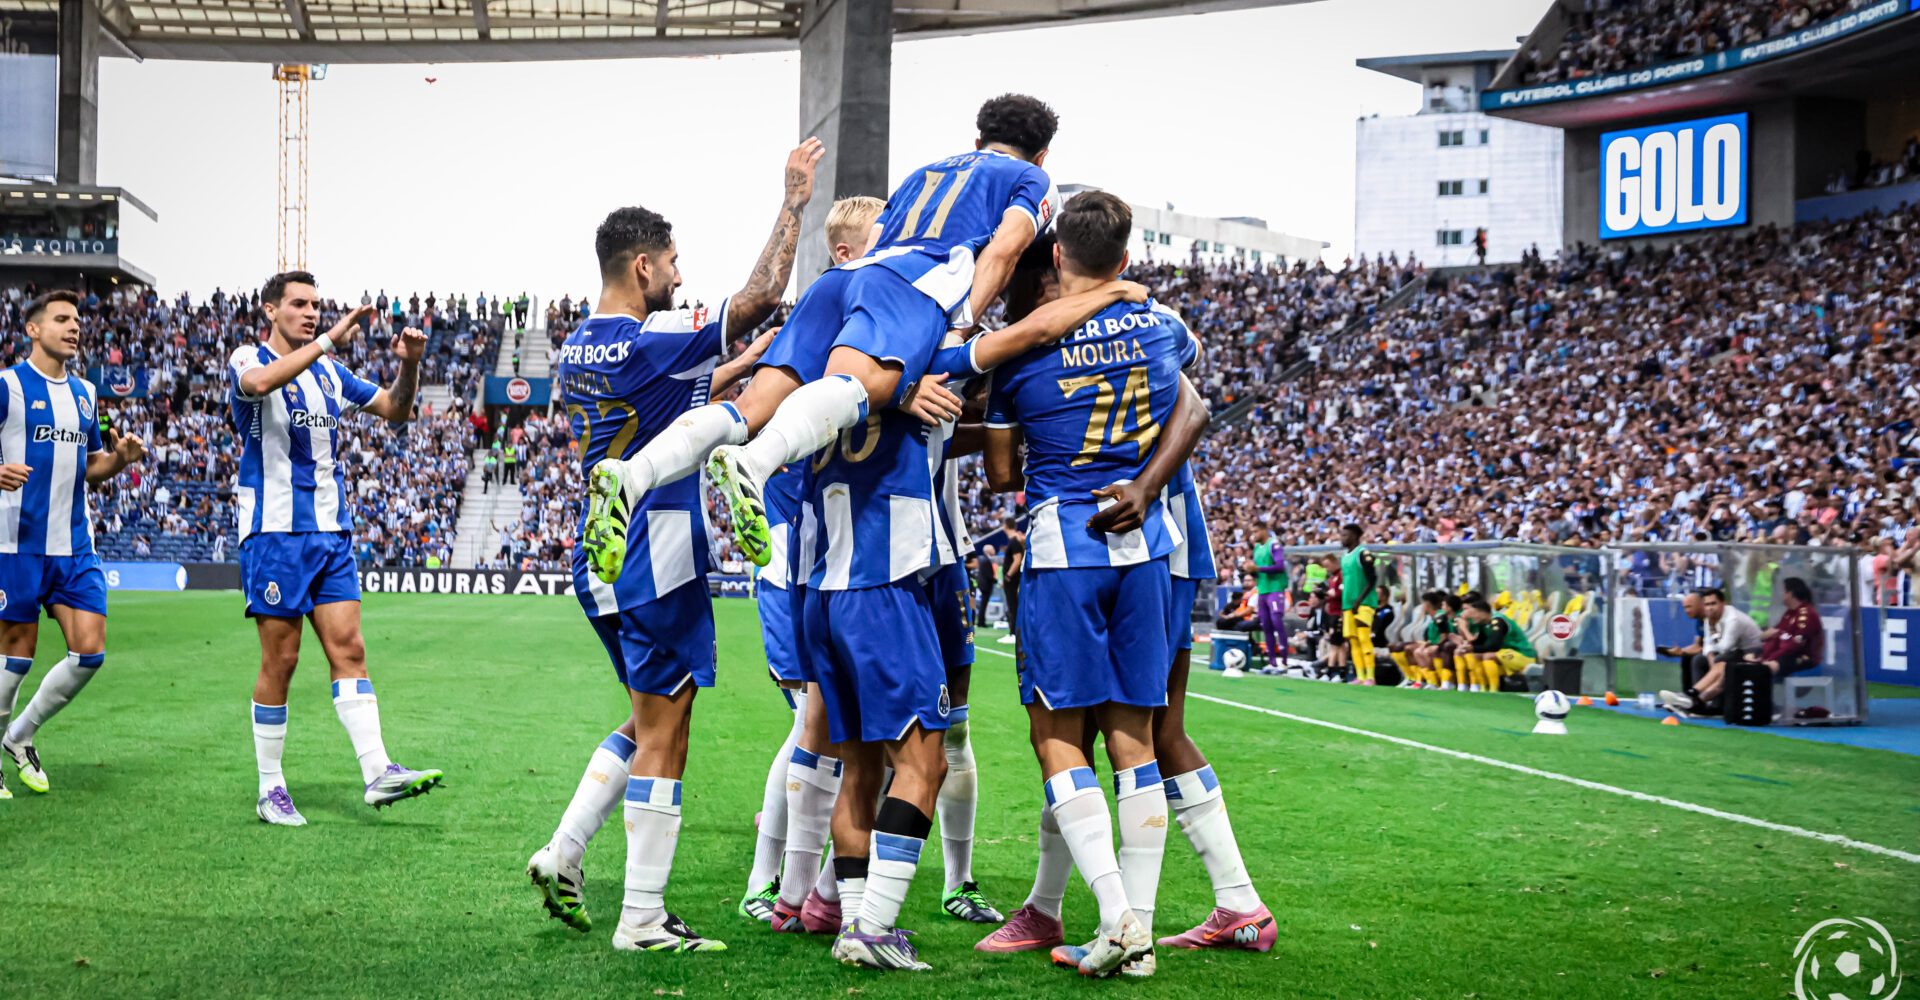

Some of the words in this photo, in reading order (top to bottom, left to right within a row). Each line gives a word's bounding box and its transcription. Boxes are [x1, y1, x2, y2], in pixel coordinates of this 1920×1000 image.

[1500, 84, 1574, 104] FUTEBOL
[1575, 74, 1628, 94] CLUBE
[1629, 70, 1652, 84] DO
[1653, 59, 1705, 79] PORTO
[1605, 123, 1741, 232] GOLO
[895, 167, 976, 242] 11
[584, 341, 632, 365] BOCK
[1061, 338, 1147, 368] MOURA
[34, 425, 88, 447] Betano
[1057, 367, 1161, 467] 74
